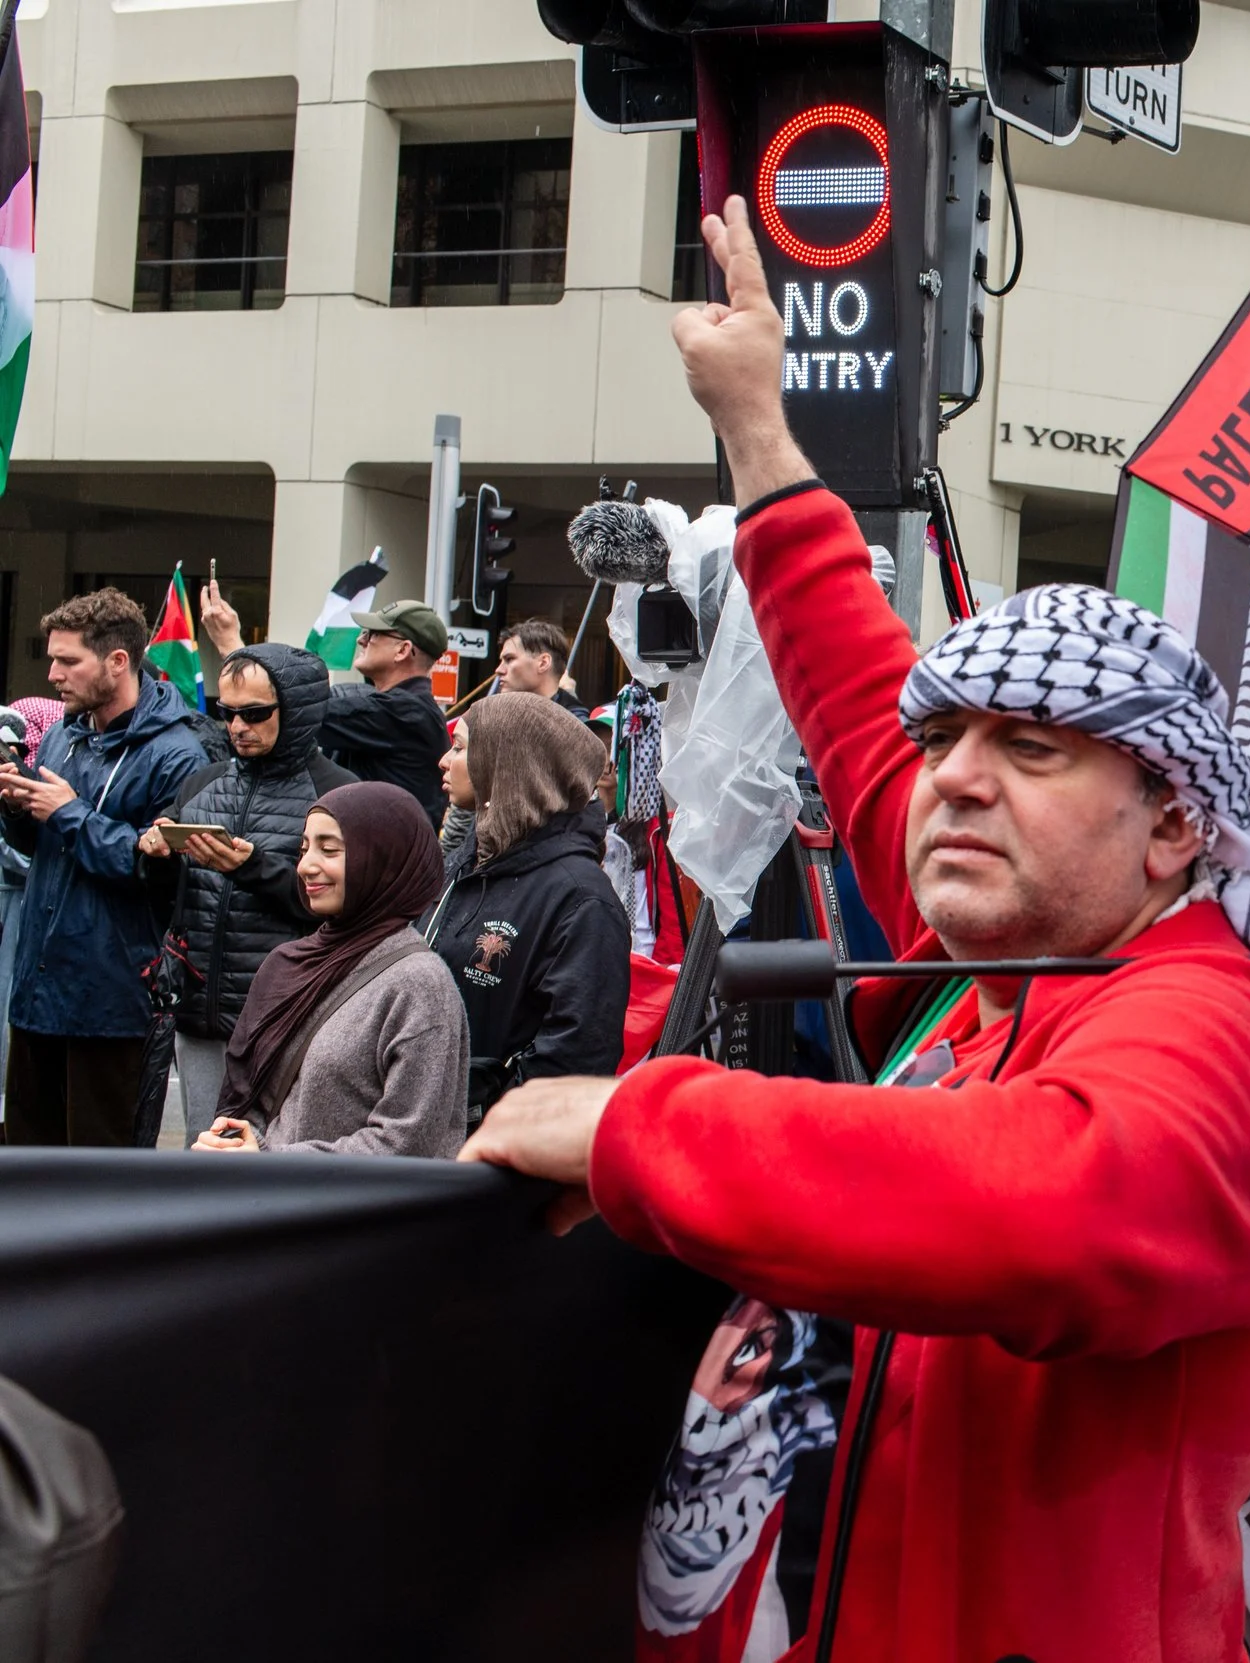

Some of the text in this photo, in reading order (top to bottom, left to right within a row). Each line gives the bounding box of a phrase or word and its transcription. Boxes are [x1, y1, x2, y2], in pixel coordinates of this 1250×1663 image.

[1105, 67, 1167, 125] TURN
[784, 281, 868, 337] NO
[783, 352, 893, 390] NTRY
[1000, 422, 1126, 458] 1 YORK
[823, 864, 838, 916] sachtler
[463, 966, 484, 977] SALTY
[483, 972, 502, 984] CREW
